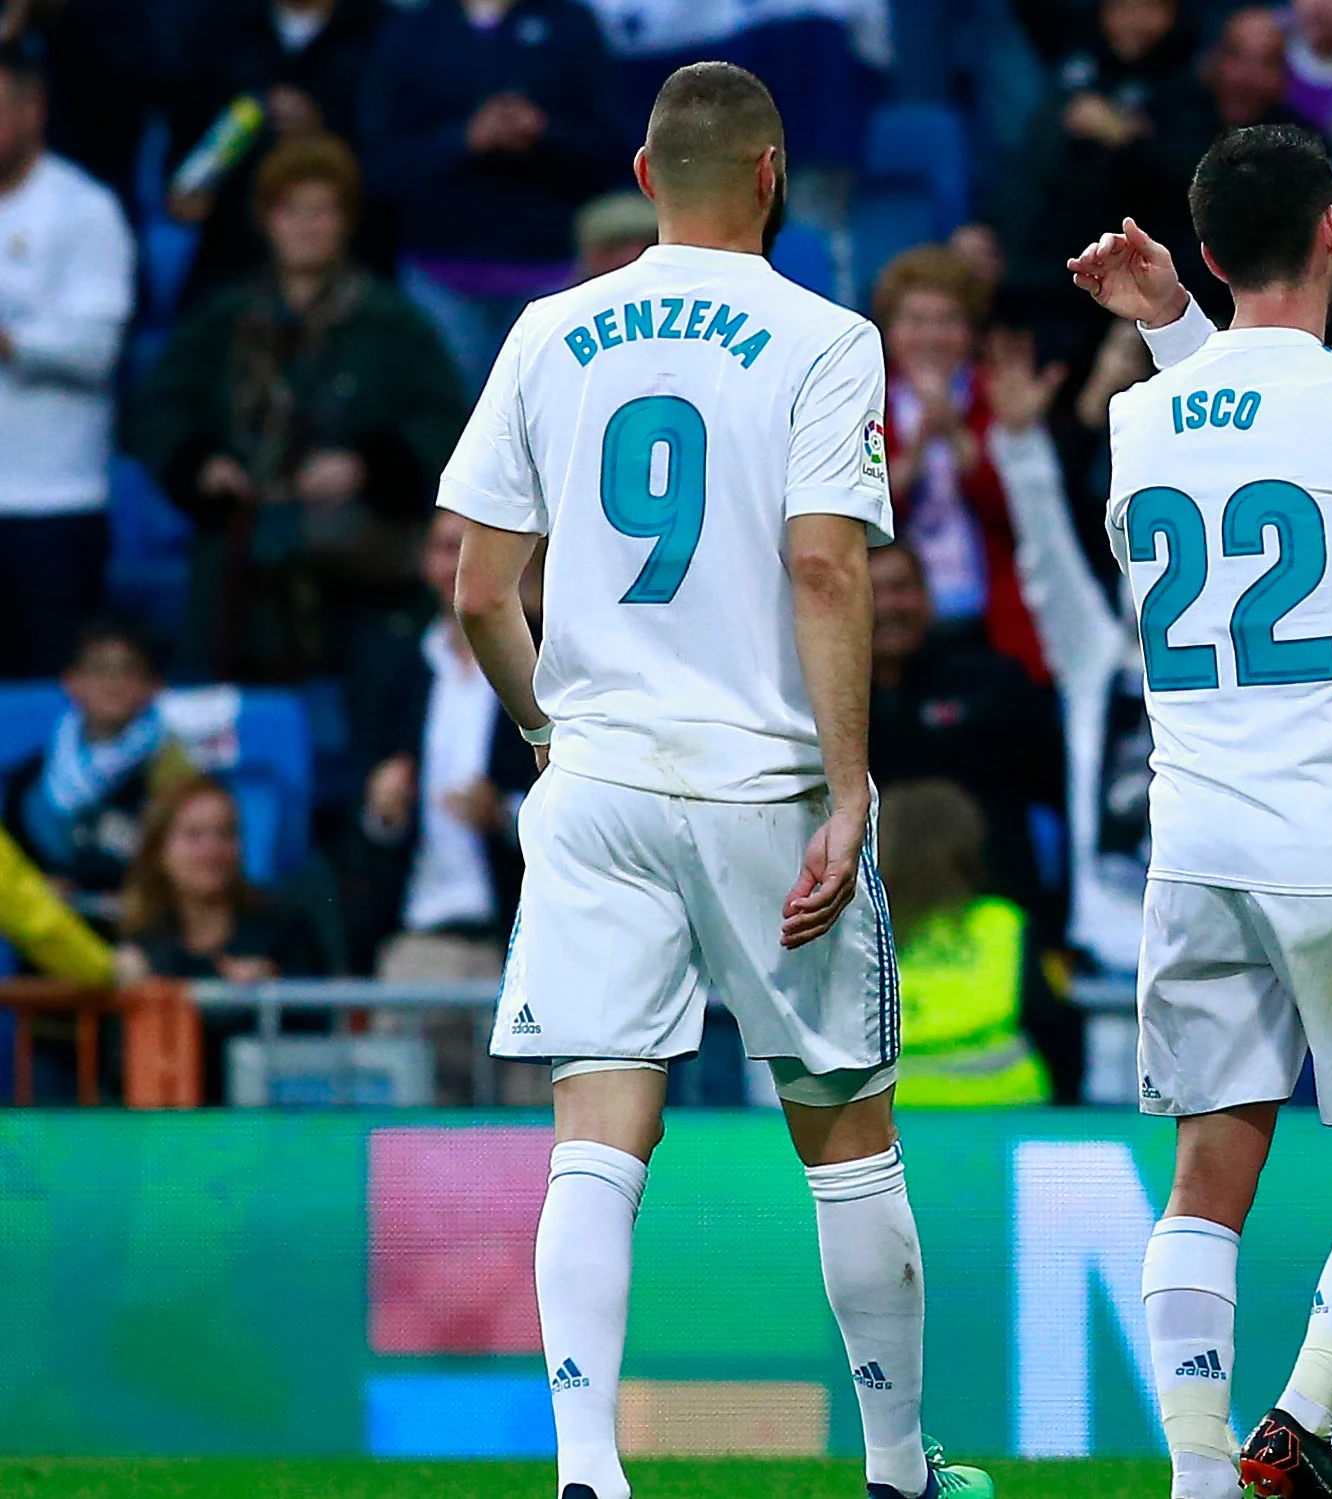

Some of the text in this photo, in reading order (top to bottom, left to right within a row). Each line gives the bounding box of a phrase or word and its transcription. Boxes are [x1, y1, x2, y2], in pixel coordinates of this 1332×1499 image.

[564, 298, 772, 370] BENZEMA
[1172, 388, 1262, 435] ISCO
[600, 395, 707, 604] 9
[511, 1022, 542, 1035] adidas
[1175, 1365, 1227, 1380] adidas
